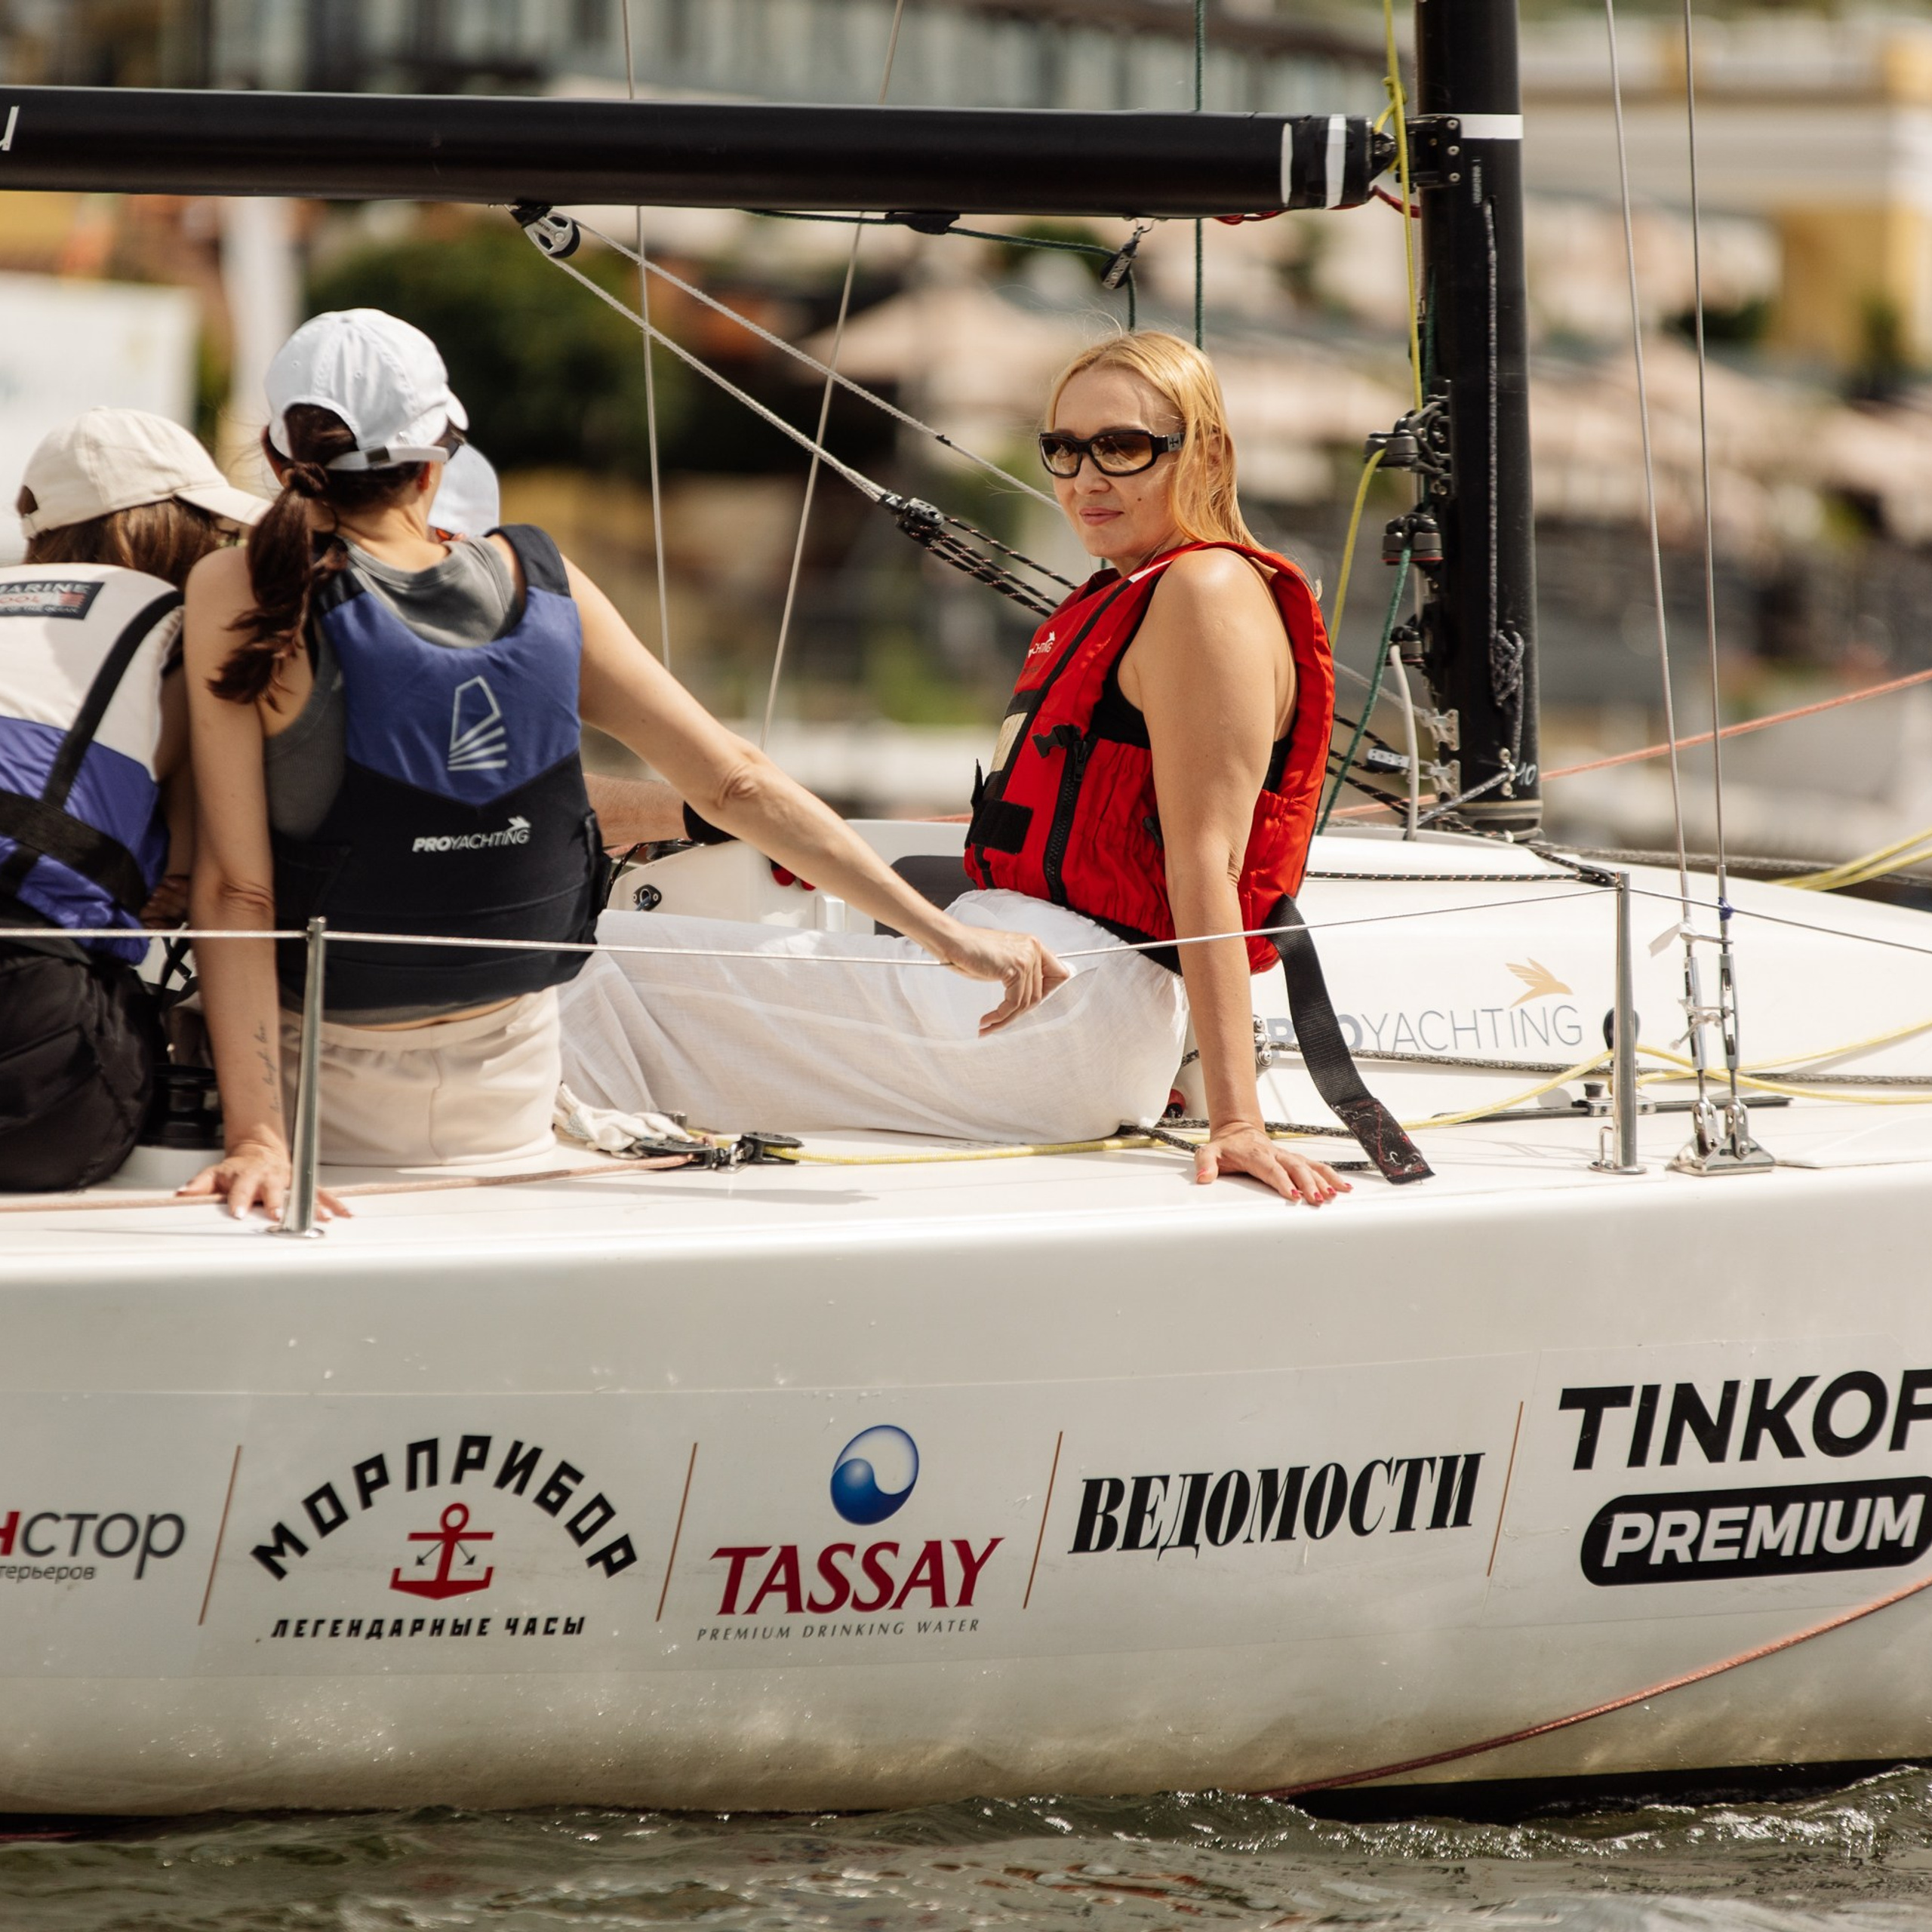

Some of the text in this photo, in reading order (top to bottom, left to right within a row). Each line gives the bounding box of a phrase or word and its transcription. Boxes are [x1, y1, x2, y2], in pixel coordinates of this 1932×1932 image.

[412, 829, 530, 853] PROYACHTING
[1266, 1004, 1583, 1060] POYACHTING
[1558, 1369, 1932, 1470] TINKOF
[250, 1435, 638, 1581] МОРПРИБОР
[1067, 1453, 1485, 1561] ВЕДОМОСТИ
[1602, 1494, 1925, 1567] PREMIUM
[709, 1537, 1006, 1616] TASSAY
[270, 1617, 586, 1640] ЛЕГЕНДАРНЫЕ ЧАСЫ
[697, 1618, 980, 1641] PREMIUM DRINKING WATER
